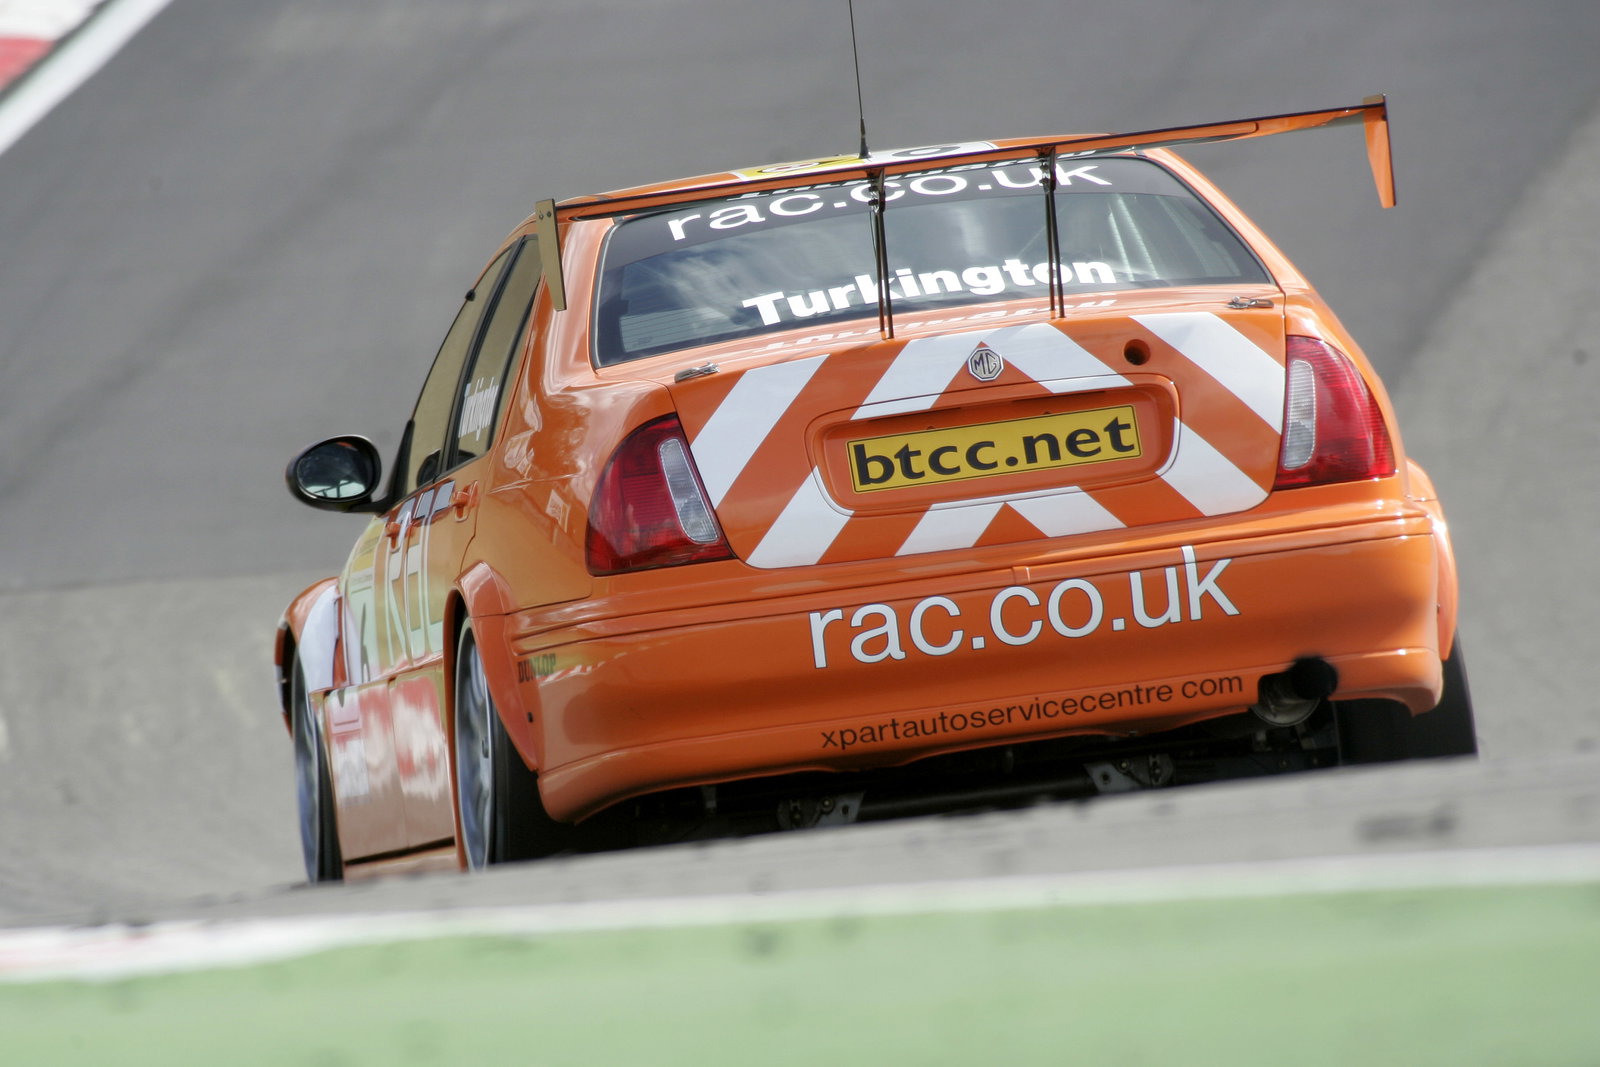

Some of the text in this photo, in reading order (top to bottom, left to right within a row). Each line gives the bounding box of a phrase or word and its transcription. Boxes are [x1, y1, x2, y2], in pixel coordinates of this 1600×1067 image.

[667, 162, 1113, 241] rac.co.uk
[742, 257, 1117, 328] Turkington
[853, 417, 1135, 486] btcc.net
[809, 545, 1240, 669] rac.co.uk
[821, 682, 1173, 750] xpartautoservicecentre
